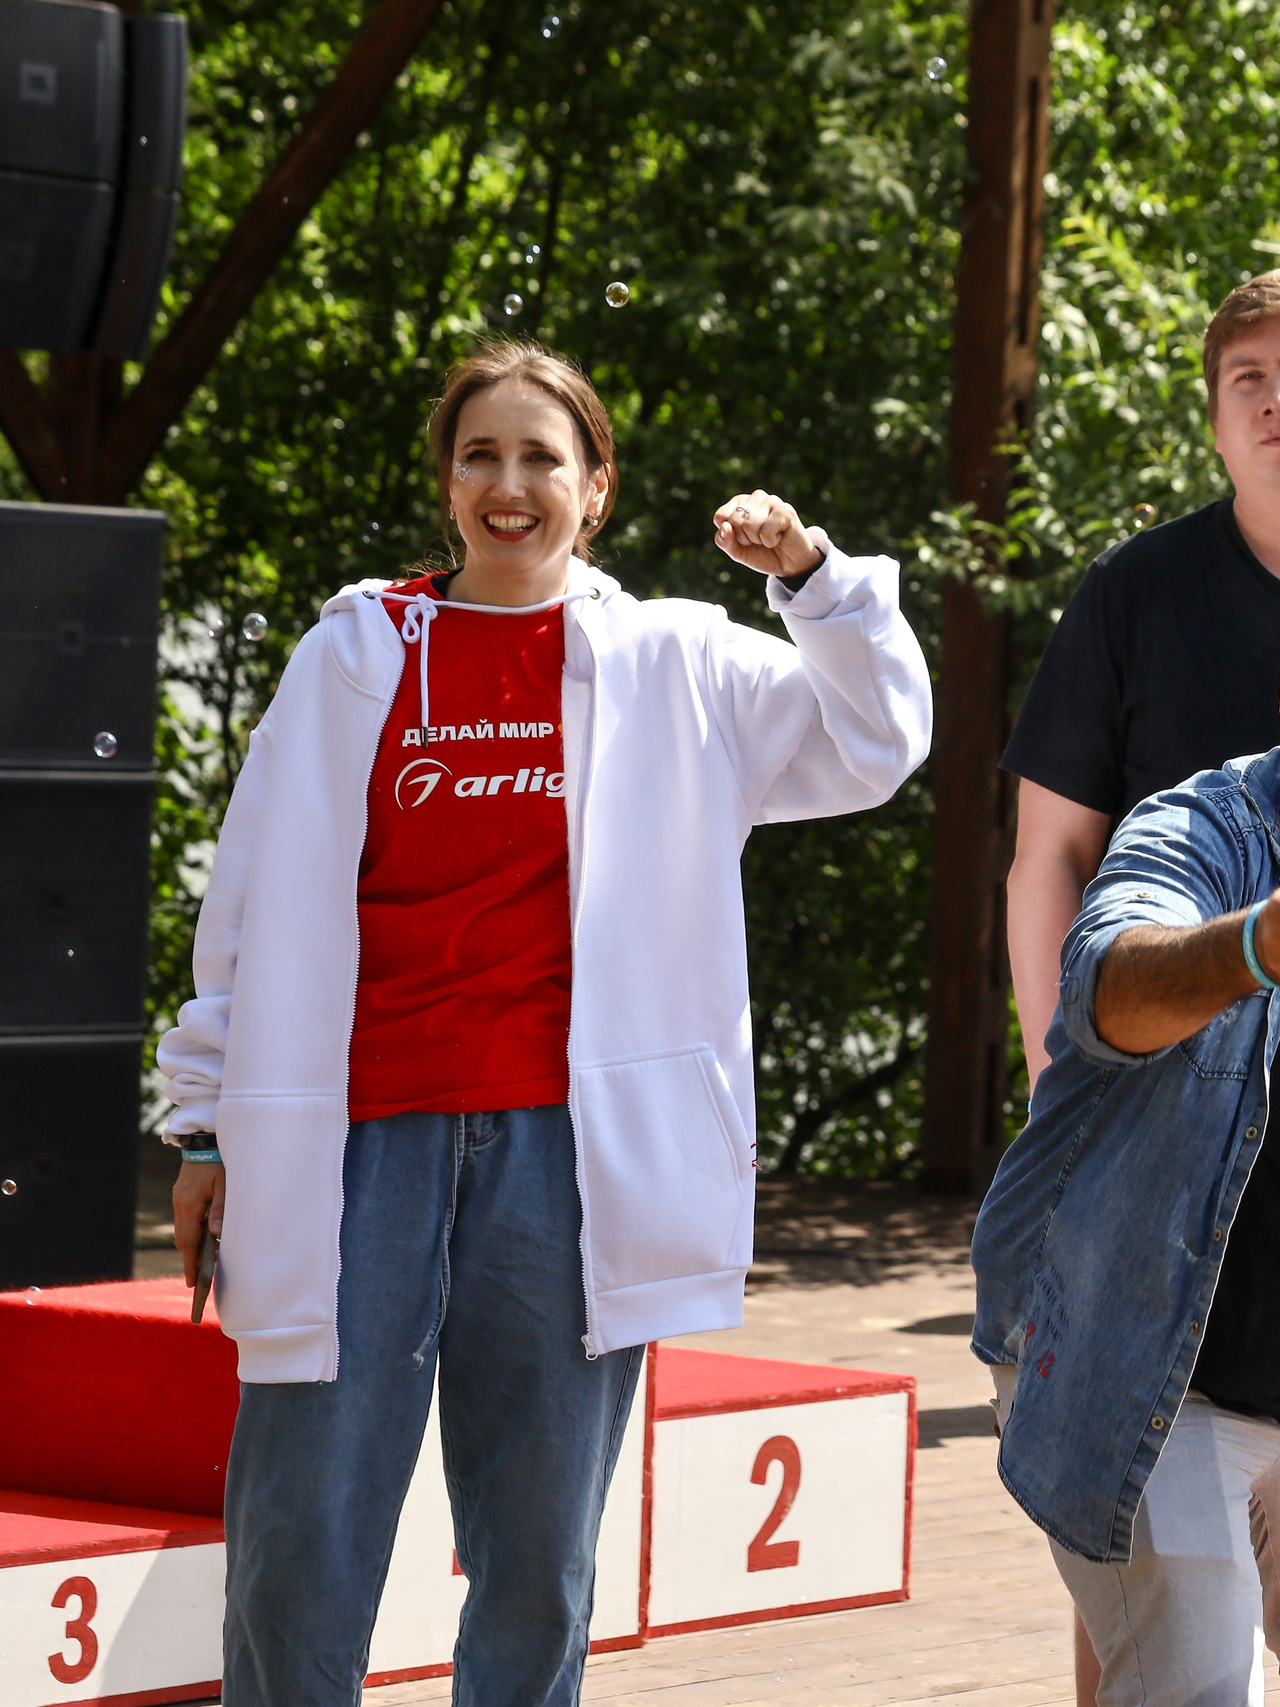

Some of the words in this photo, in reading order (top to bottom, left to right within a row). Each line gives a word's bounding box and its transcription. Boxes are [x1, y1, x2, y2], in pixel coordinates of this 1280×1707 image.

[401, 718, 495, 748] ДЕЛАЙ
[498, 721, 554, 739] МИР
[746, 1434, 803, 1573] 2
[47, 1575, 99, 1685] 3
